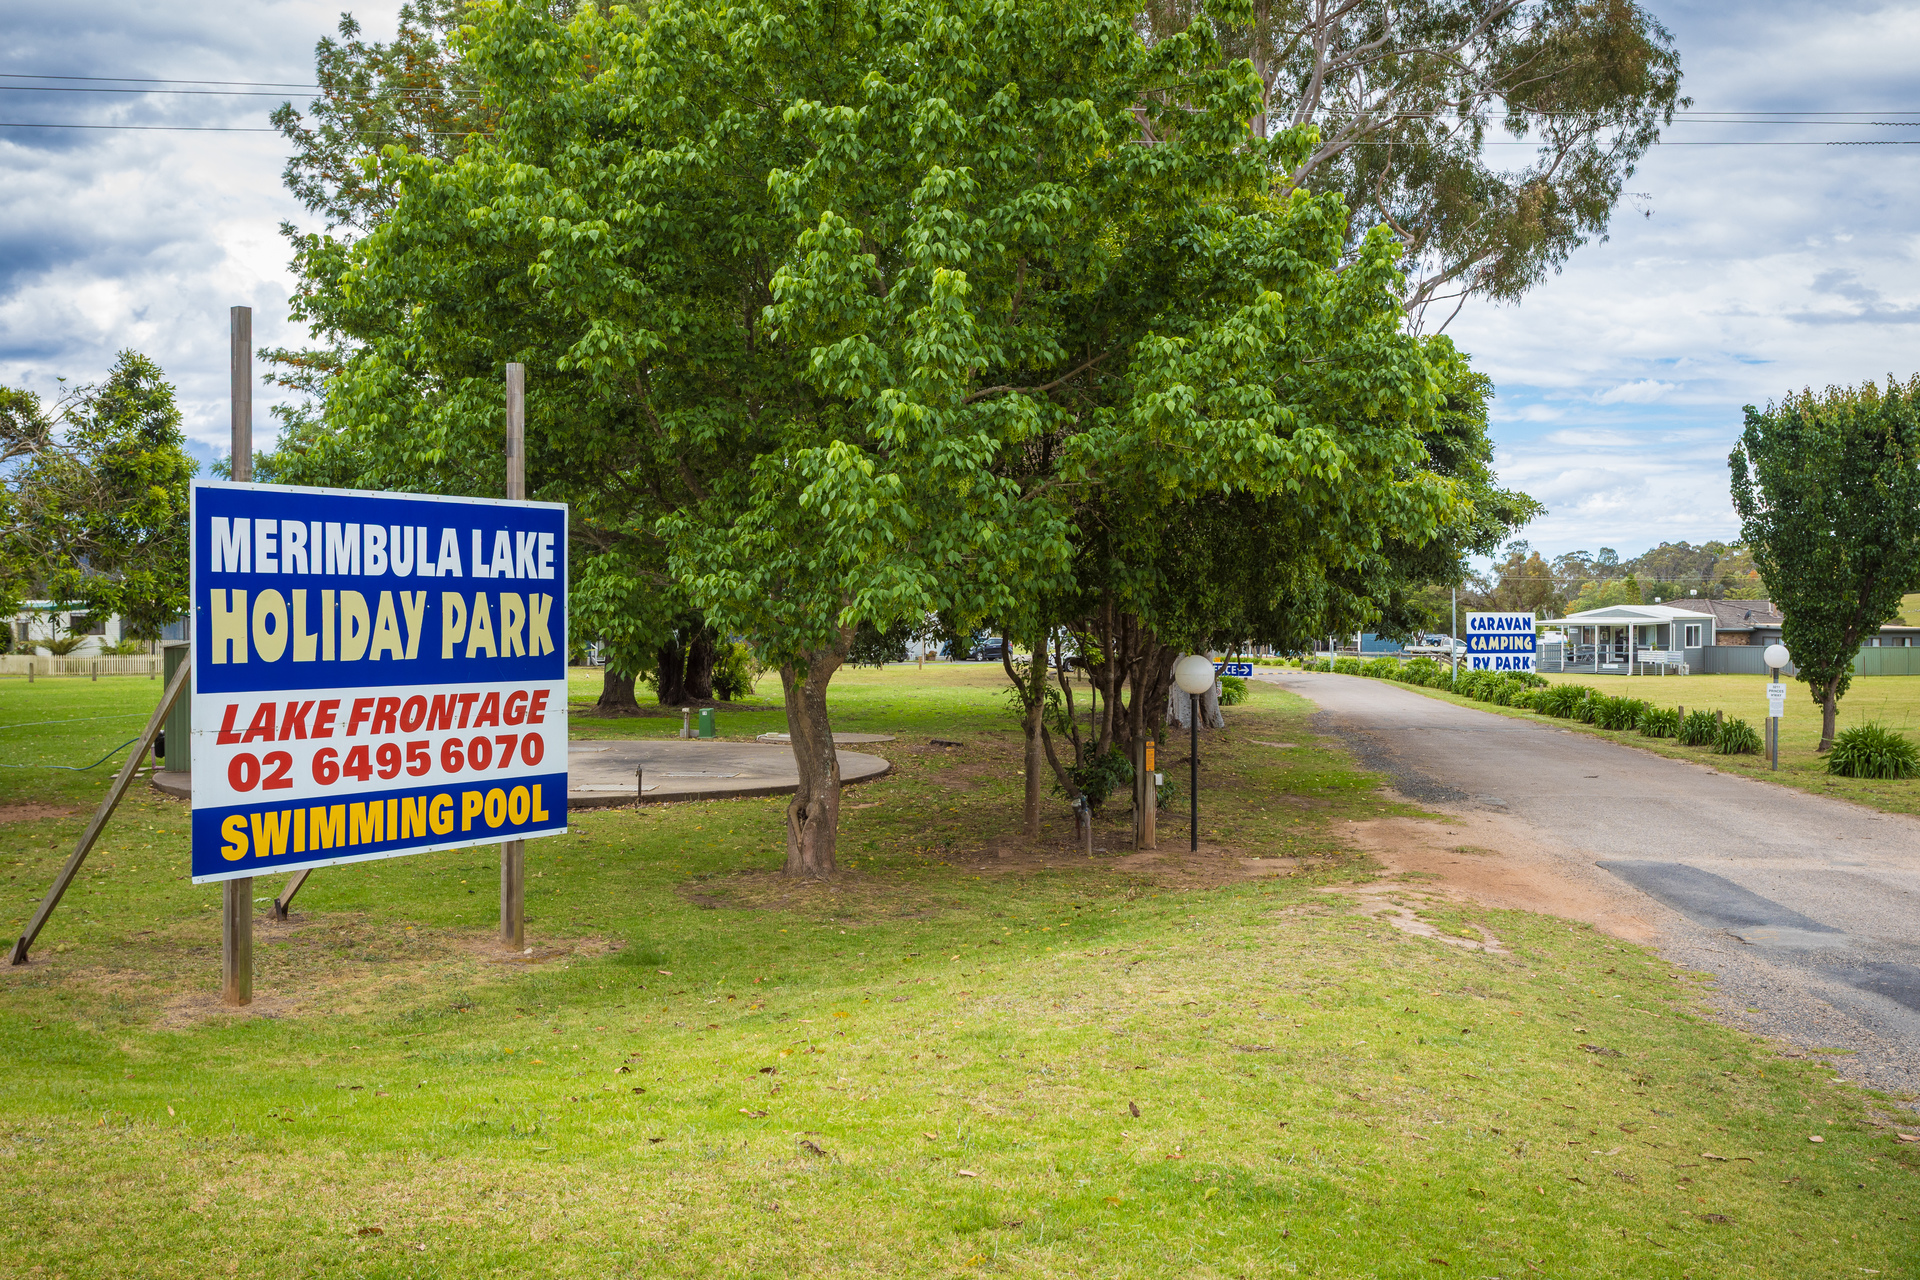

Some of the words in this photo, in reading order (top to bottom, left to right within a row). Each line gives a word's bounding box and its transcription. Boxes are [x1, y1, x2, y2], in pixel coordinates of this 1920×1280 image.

[211, 516, 463, 578] MERIMBULA
[471, 528, 555, 580] LAKE
[210, 588, 427, 665] HOLIDAY
[441, 591, 555, 660] PARK
[1470, 617, 1531, 631] CARAVAN
[1470, 636, 1532, 651] CAMPING
[1473, 656, 1490, 670] RV
[1495, 656, 1530, 670] PARK
[215, 699, 341, 746] LAKE
[345, 689, 550, 737] FRONTAGE
[227, 750, 294, 793] 02
[311, 740, 432, 786] 6495
[440, 732, 545, 774] 6070
[220, 793, 454, 862] SWIMMING
[461, 784, 549, 832] POOL
